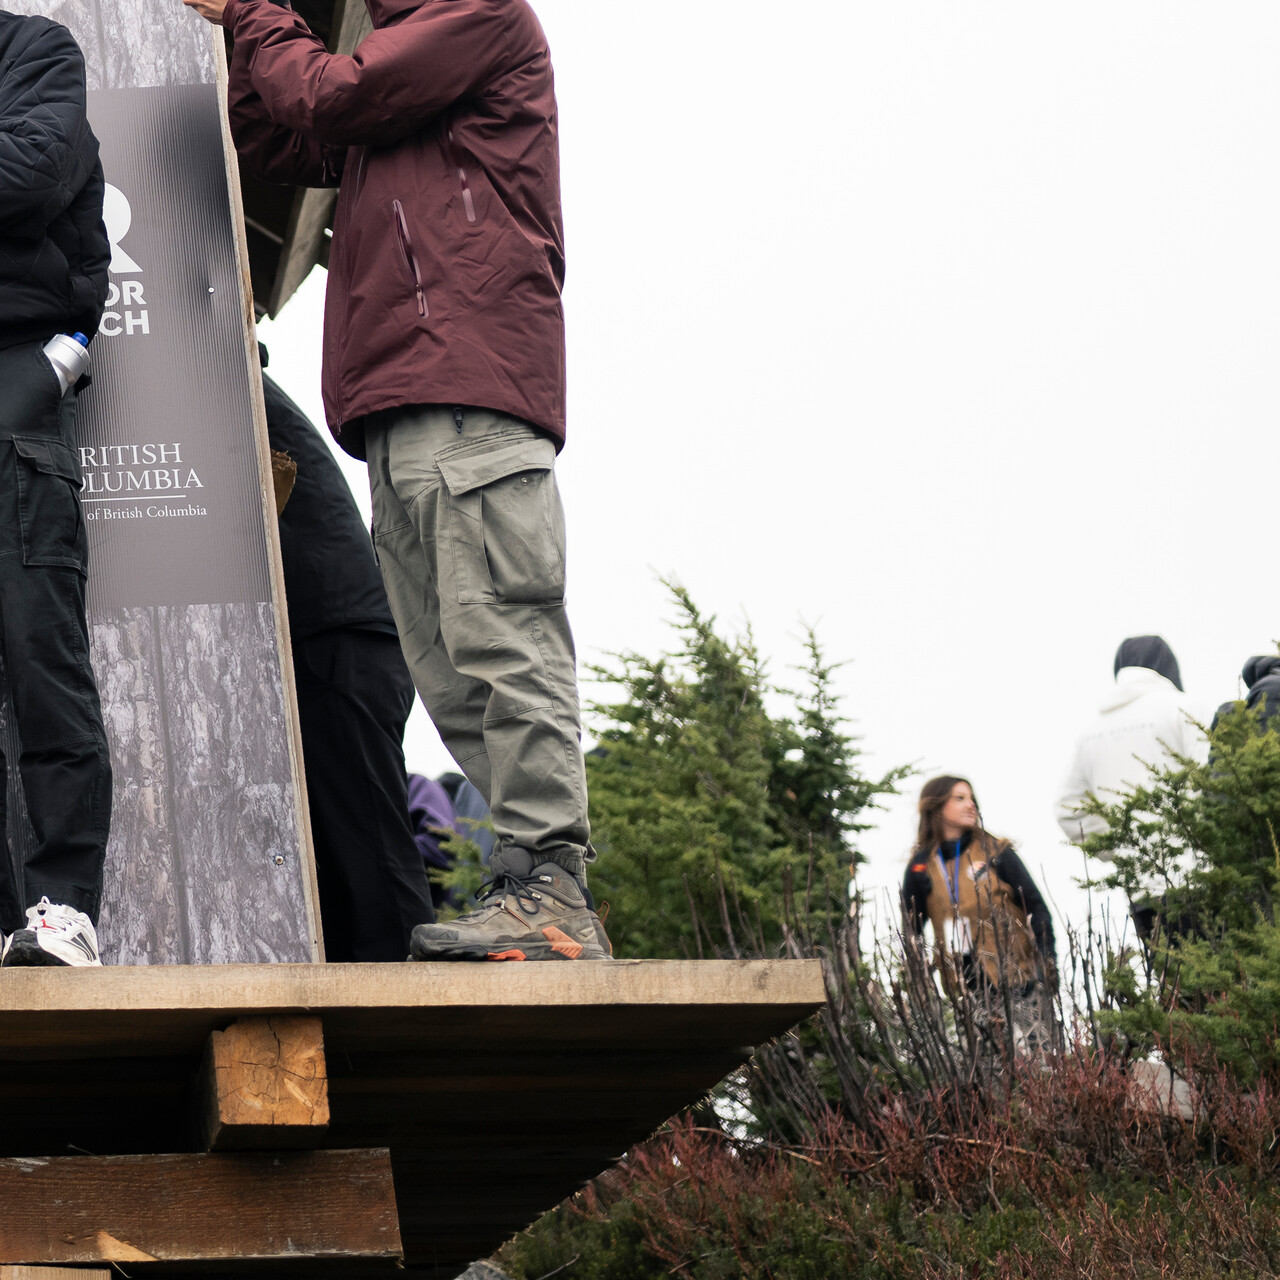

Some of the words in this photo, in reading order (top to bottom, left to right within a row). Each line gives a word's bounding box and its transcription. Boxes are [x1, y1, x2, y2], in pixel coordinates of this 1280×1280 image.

[98, 309, 150, 337] CH
[78, 442, 183, 467] RITISH
[79, 468, 205, 493] LUMBIA
[87, 508, 101, 520] of
[103, 506, 143, 520] British
[146, 504, 208, 518] Columbia
